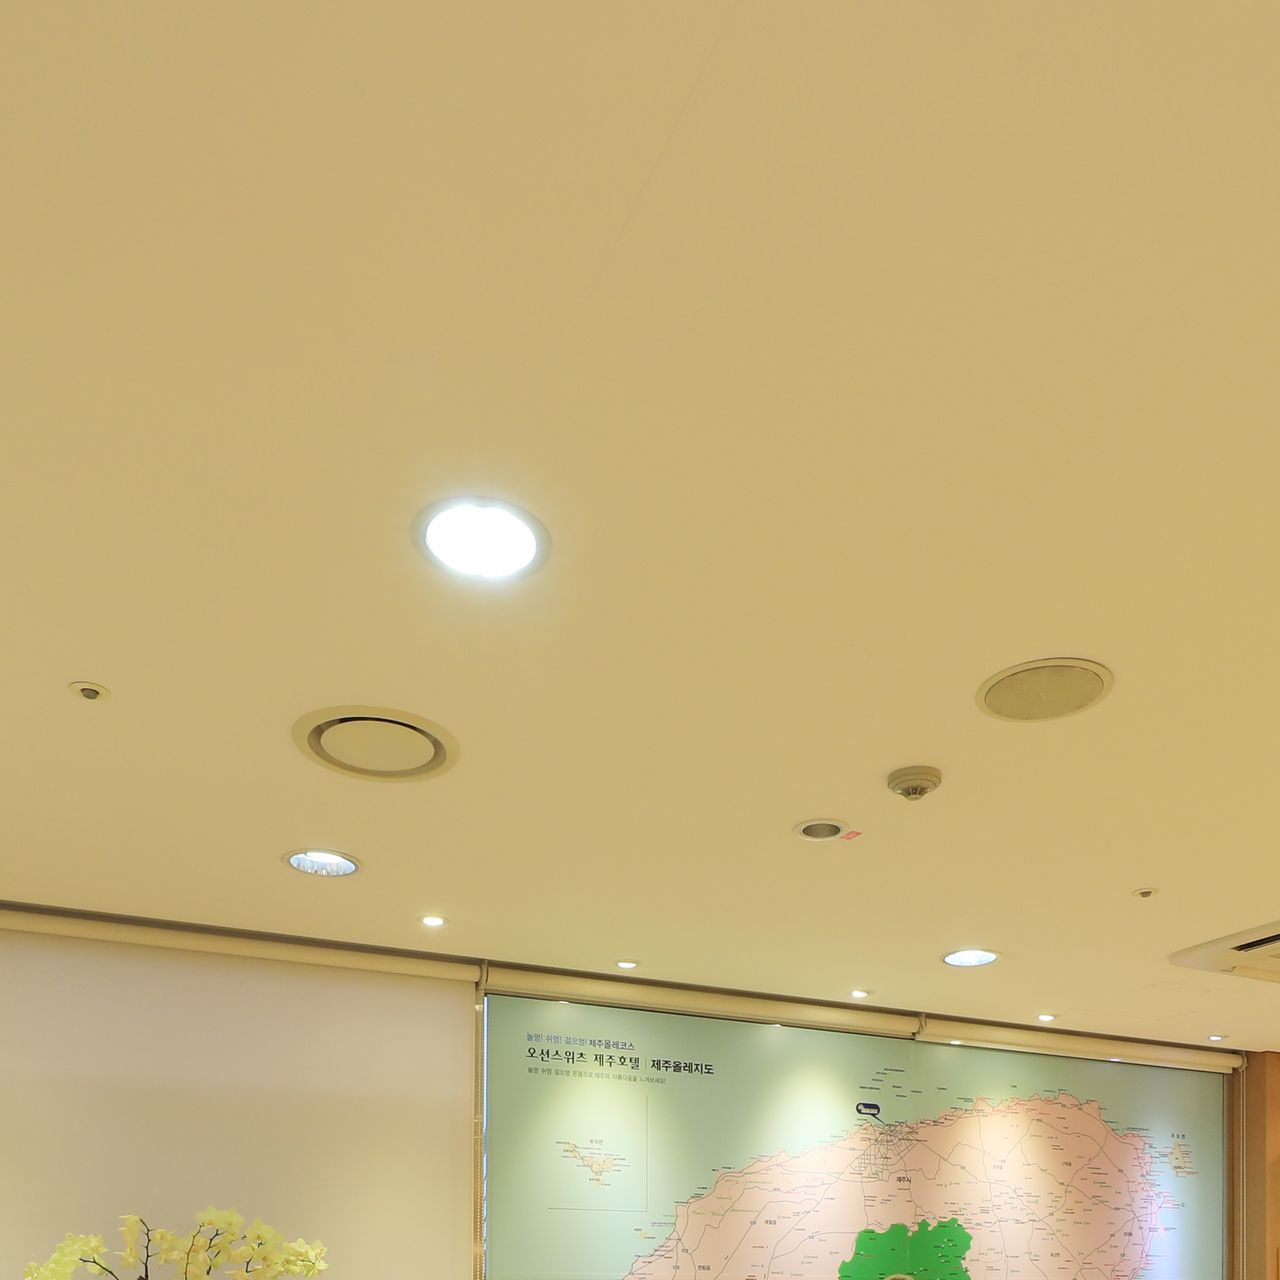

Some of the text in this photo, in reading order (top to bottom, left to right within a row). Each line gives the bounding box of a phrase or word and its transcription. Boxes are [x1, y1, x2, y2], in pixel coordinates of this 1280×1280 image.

[589, 1039, 635, 1050] 제주올레코스
[526, 1047, 715, 1075] 오션스위츠 제주호텔 제주올레지도
